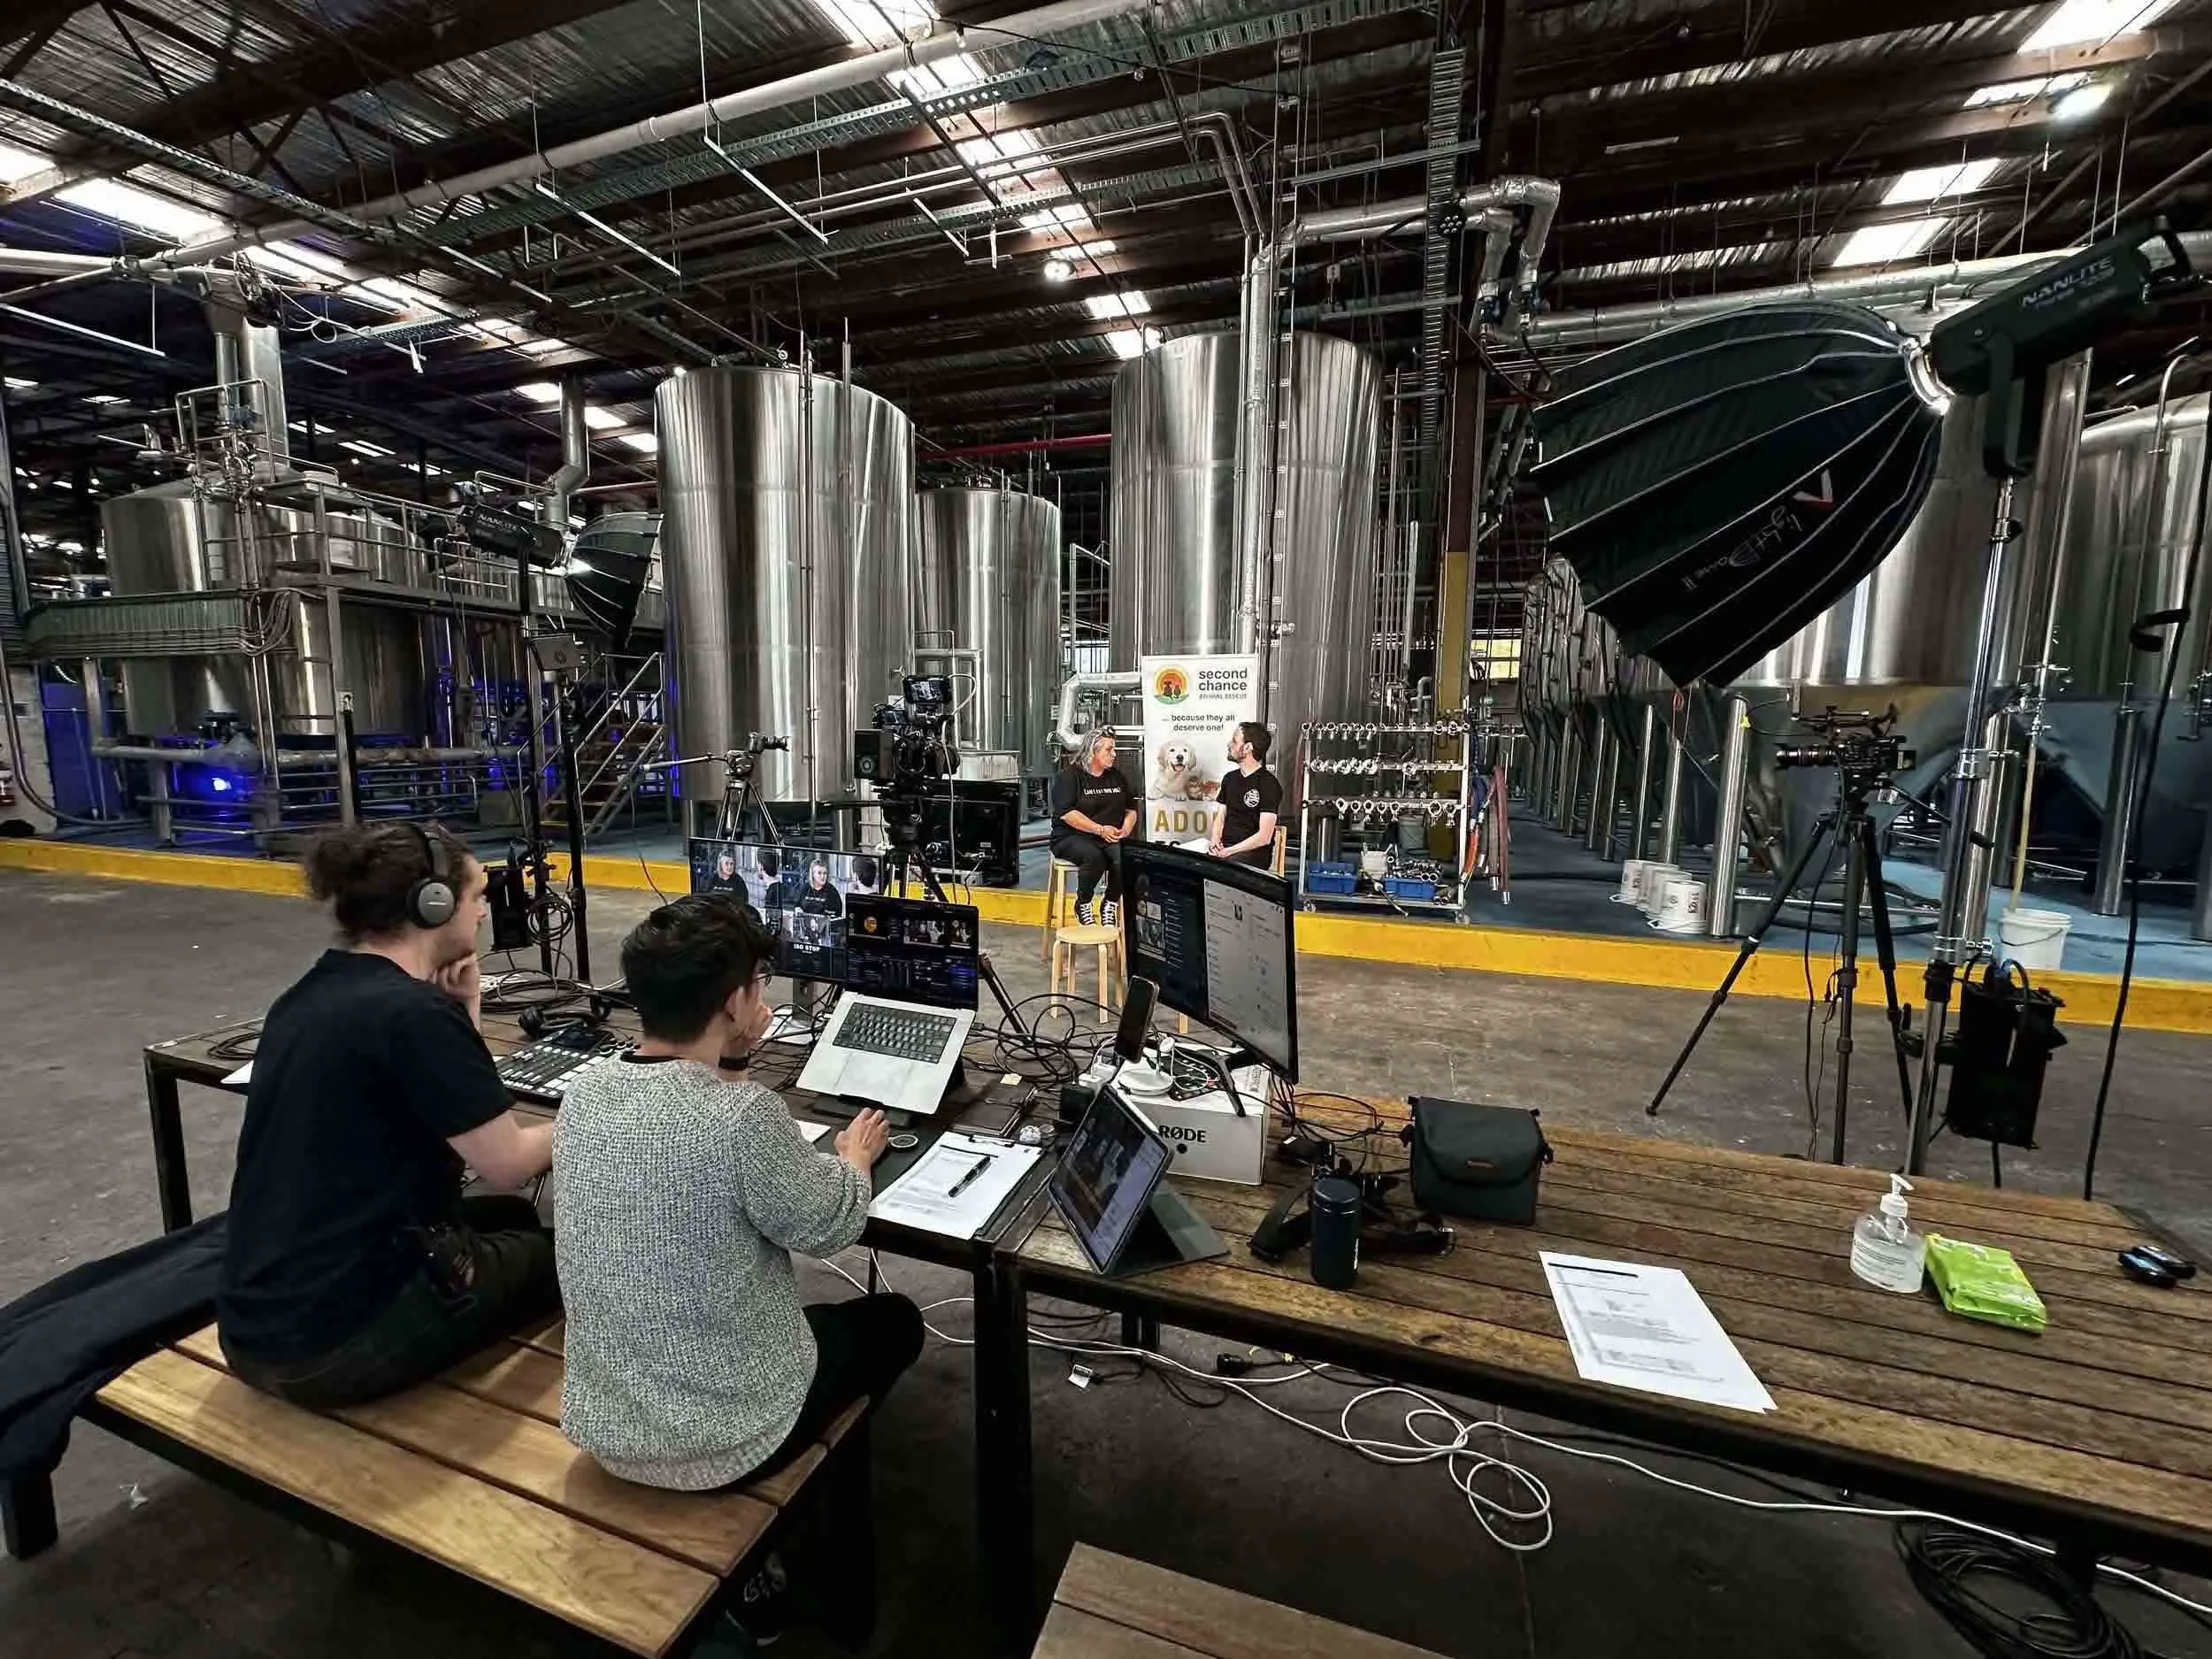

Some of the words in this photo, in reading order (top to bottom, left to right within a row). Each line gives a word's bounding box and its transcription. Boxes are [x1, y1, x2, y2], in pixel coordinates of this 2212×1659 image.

[2021, 256, 2111, 307] NANLITE
[1199, 667, 1248, 680] second
[1199, 680, 1248, 691] chance
[1206, 714, 1223, 723] they
[1155, 809, 1218, 833] ADO
[1158, 1125, 1207, 1143] RØDE
